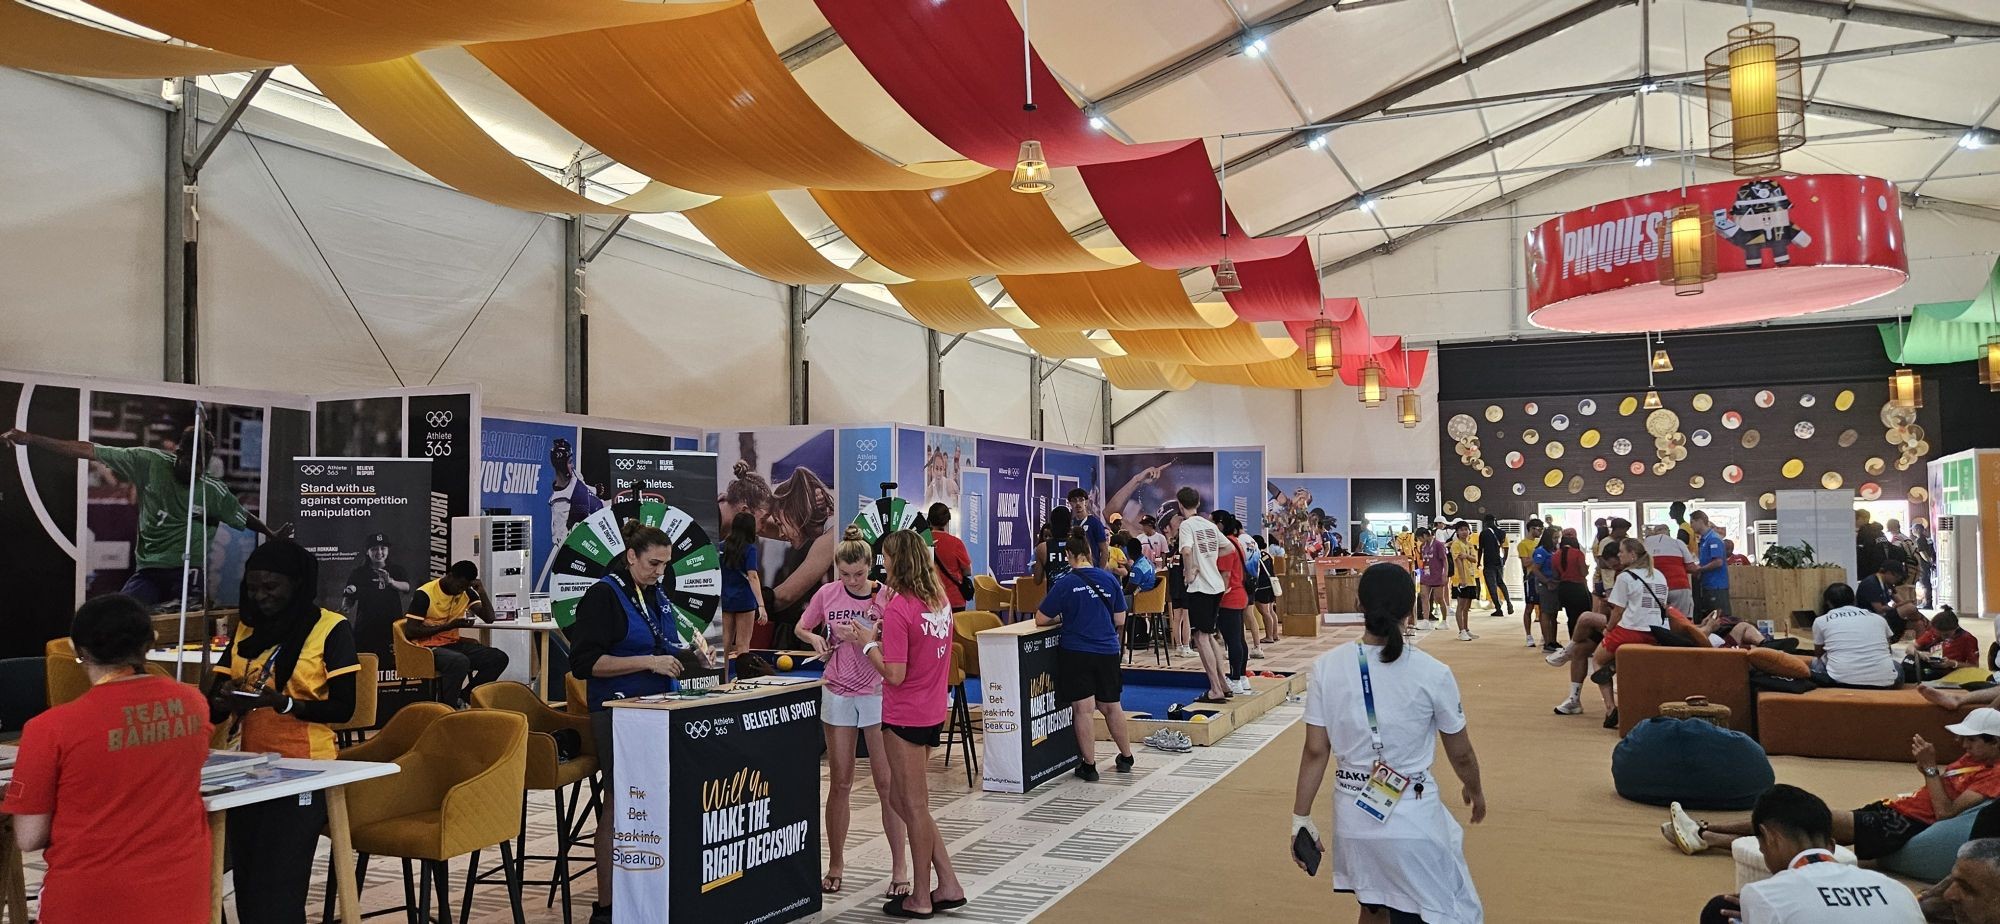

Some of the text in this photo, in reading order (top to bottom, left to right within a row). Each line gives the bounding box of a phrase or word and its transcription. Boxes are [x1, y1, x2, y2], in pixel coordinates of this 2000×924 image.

[1562, 209, 1676, 279] PINQUEST
[426, 432, 453, 440] Athlete
[425, 441, 452, 456] 365
[487, 431, 547, 461] SOLIDARITY
[856, 460, 877, 472] 365
[480, 461, 541, 494] YOU SHINE
[616, 479, 674, 488] Rea hletes.
[1231, 475, 1250, 483] 365
[300, 483, 334, 492] Stand
[336, 483, 360, 492] with
[300, 496, 408, 506] against competition
[997, 493, 1020, 518] UNLOCK
[300, 508, 371, 518] manipulation
[969, 533, 978, 545] BE
[997, 521, 1013, 546] YOUR
[430, 536, 447, 554] IN
[686, 555, 705, 566] BETTING
[688, 597, 704, 607] FIXING
[692, 674, 719, 690] DECISION
[989, 682, 1002, 691] Fix
[989, 696, 1003, 704] Bet
[1030, 691, 1056, 718] MAKE THE
[122, 698, 185, 726] TEAM
[713, 700, 817, 731] Athlete BELIEVE IN SPORT
[984, 708, 1015, 717] eak info
[1006, 723, 1015, 732] up
[1031, 706, 1073, 740] RIGHT DECISION?
[714, 726, 728, 736] 365
[629, 786, 645, 800] Fix
[703, 767, 769, 812] Will You
[628, 807, 647, 821] Bet
[703, 797, 771, 845] MAKE THE
[613, 828, 661, 844] Leak info
[612, 848, 661, 867] Speak up
[703, 820, 808, 884] RIGHT DECISION?
[1816, 885, 1889, 907] EGYPT
